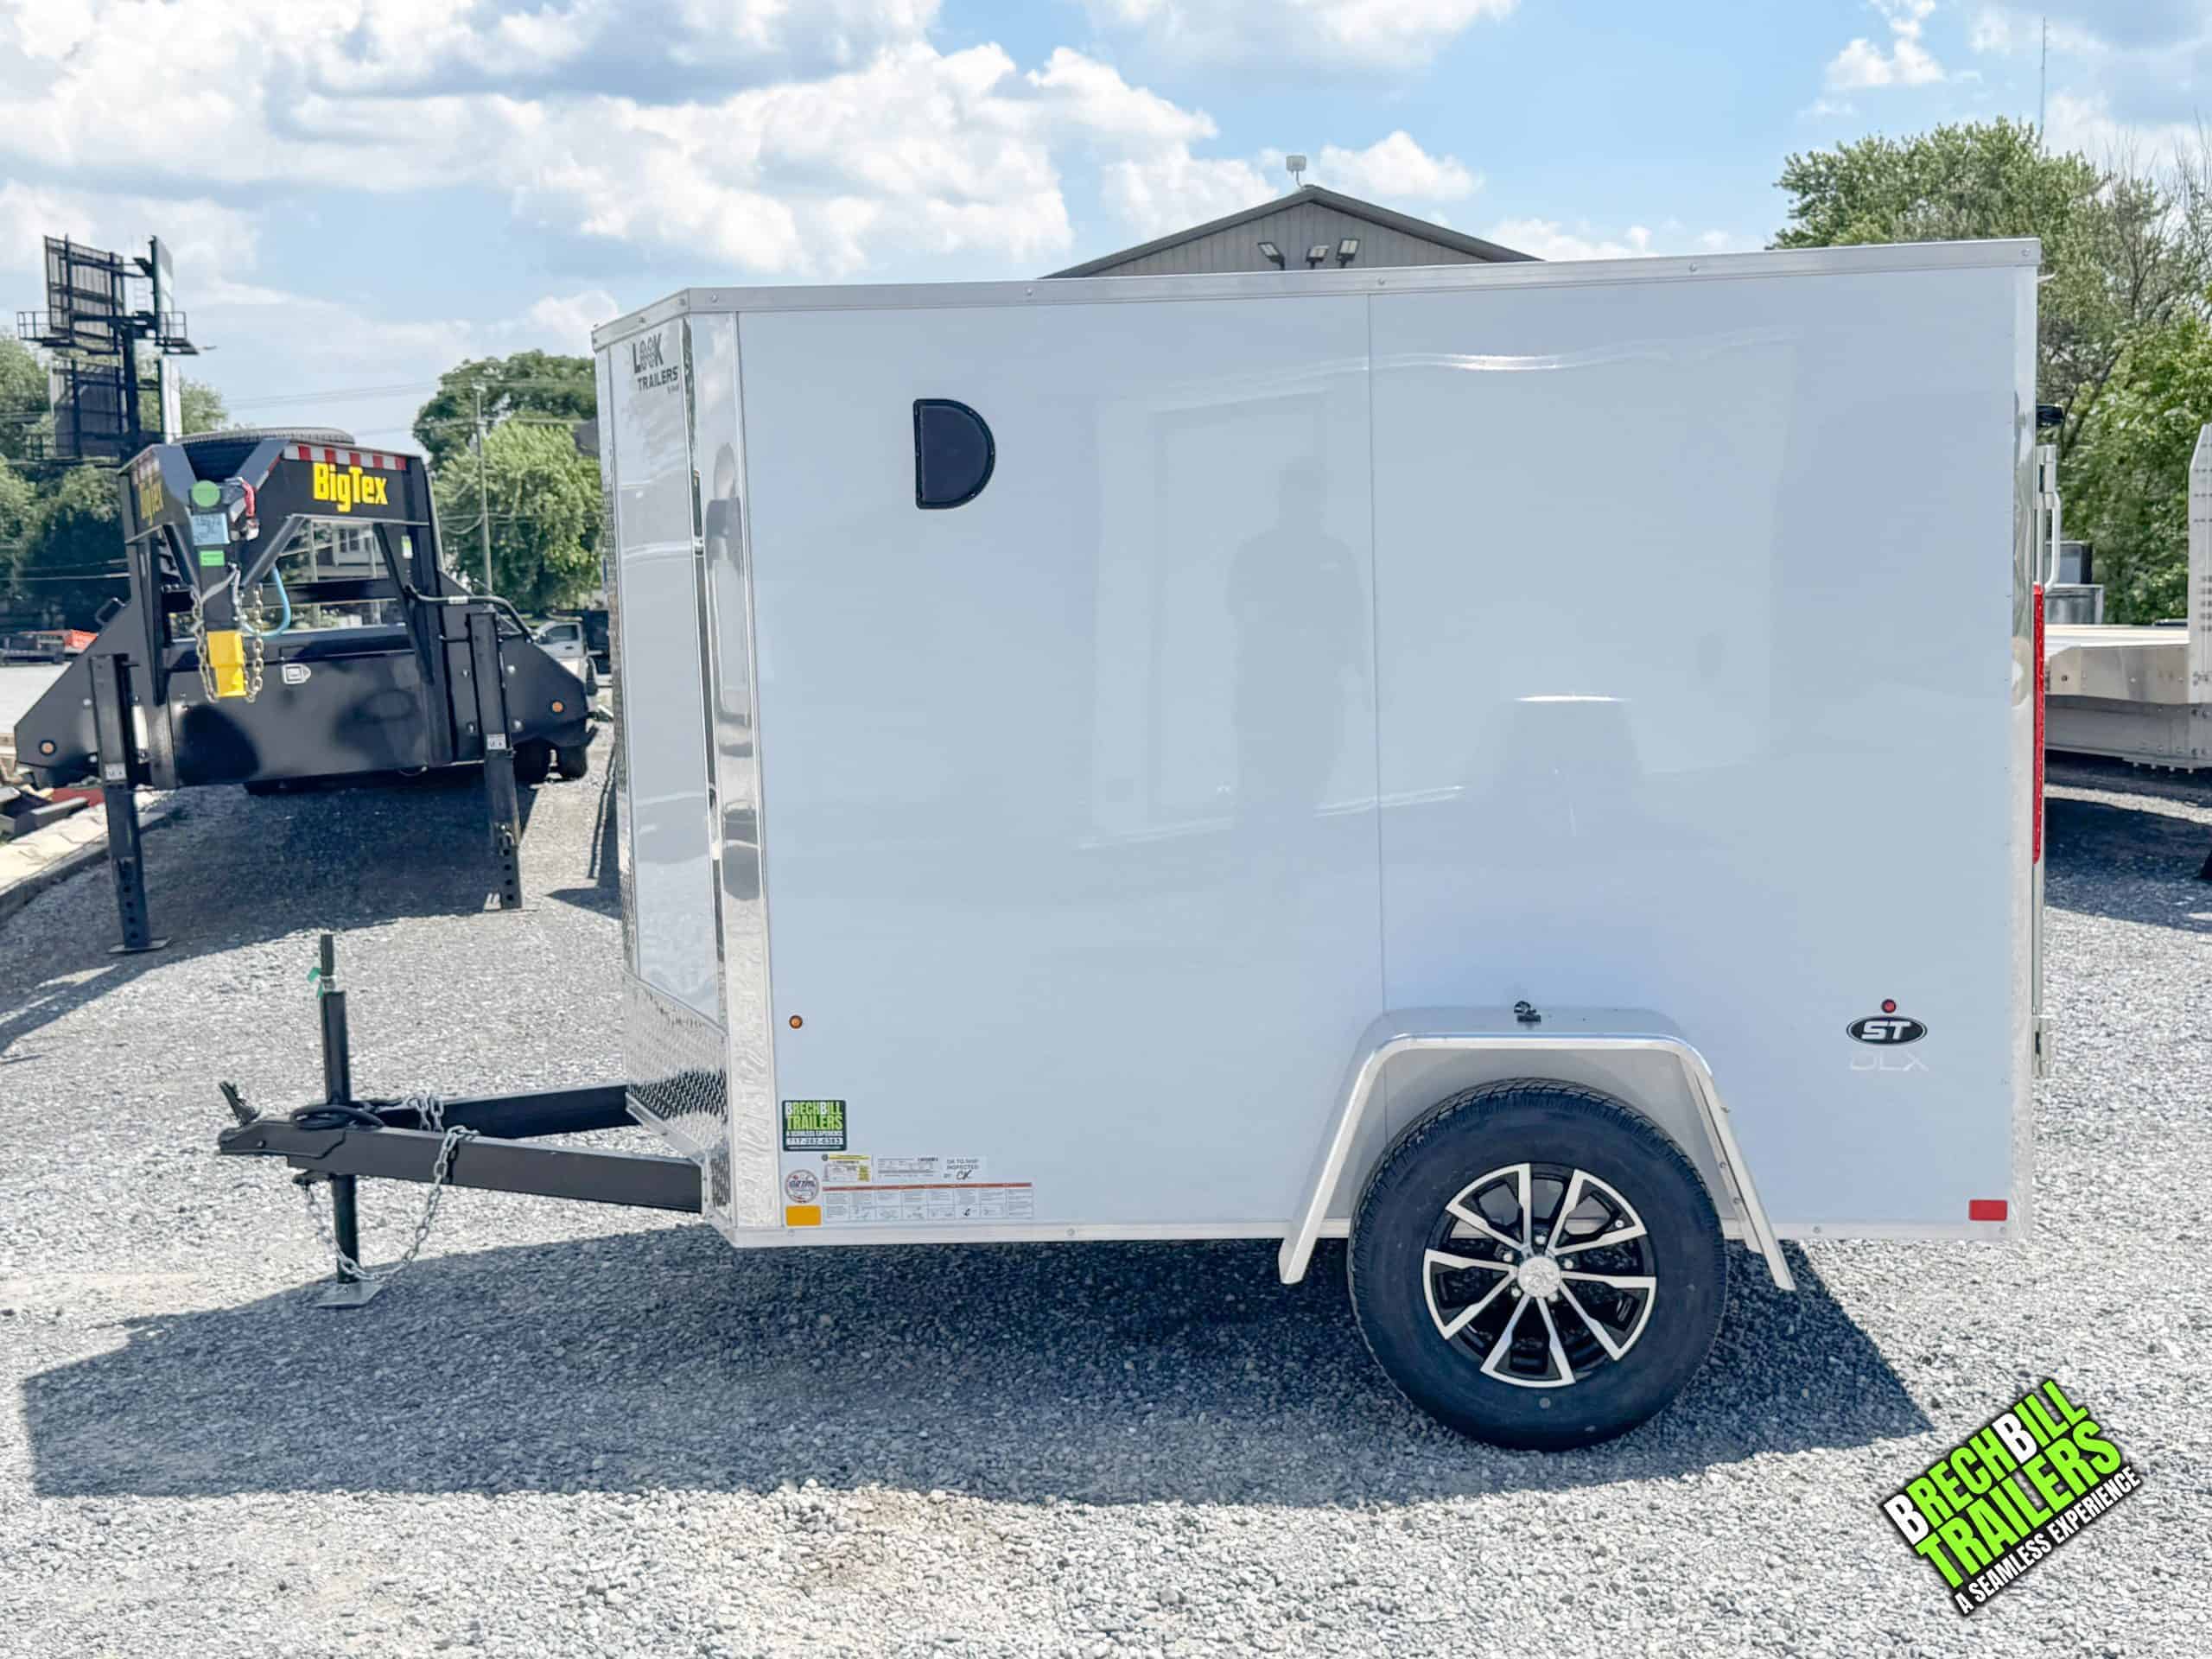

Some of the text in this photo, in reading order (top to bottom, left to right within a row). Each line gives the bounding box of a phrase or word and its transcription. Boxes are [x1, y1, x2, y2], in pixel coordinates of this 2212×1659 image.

[637, 365, 678, 391] TRAILERS
[313, 461, 389, 512] BigTex
[1860, 1020, 1911, 1040] ST
[785, 1101, 842, 1115] BRECHBILL
[787, 1115, 843, 1130] TRAILERS
